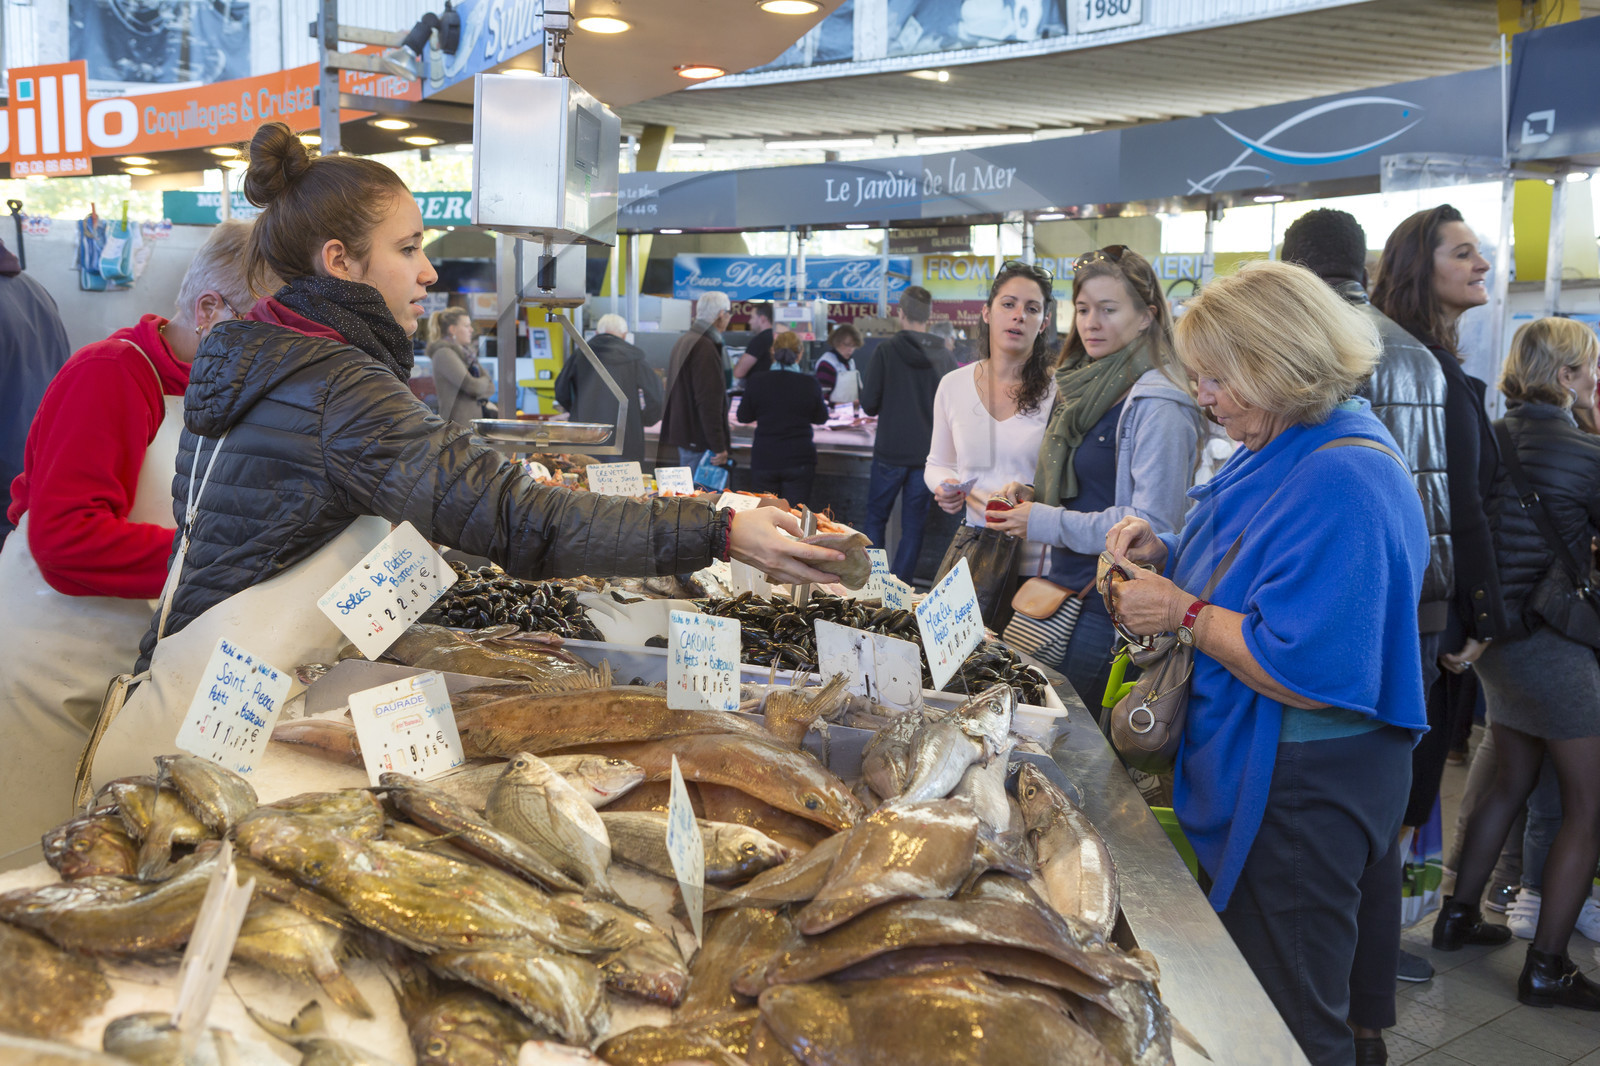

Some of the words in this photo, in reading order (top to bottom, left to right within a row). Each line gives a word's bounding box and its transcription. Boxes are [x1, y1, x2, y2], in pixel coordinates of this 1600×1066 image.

[1085, 0, 1132, 20] 1980
[0, 73, 139, 156] illo
[144, 100, 238, 139] Coquillages
[241, 92, 254, 121] &
[825, 179, 850, 202] Le
[854, 171, 917, 207] Jardin
[923, 169, 943, 195] de
[948, 158, 966, 193] la
[972, 164, 1017, 191] Mer
[827, 303, 892, 318] RAITEUR
[336, 587, 371, 615] Soles
[375, 694, 425, 716] DAURADE
